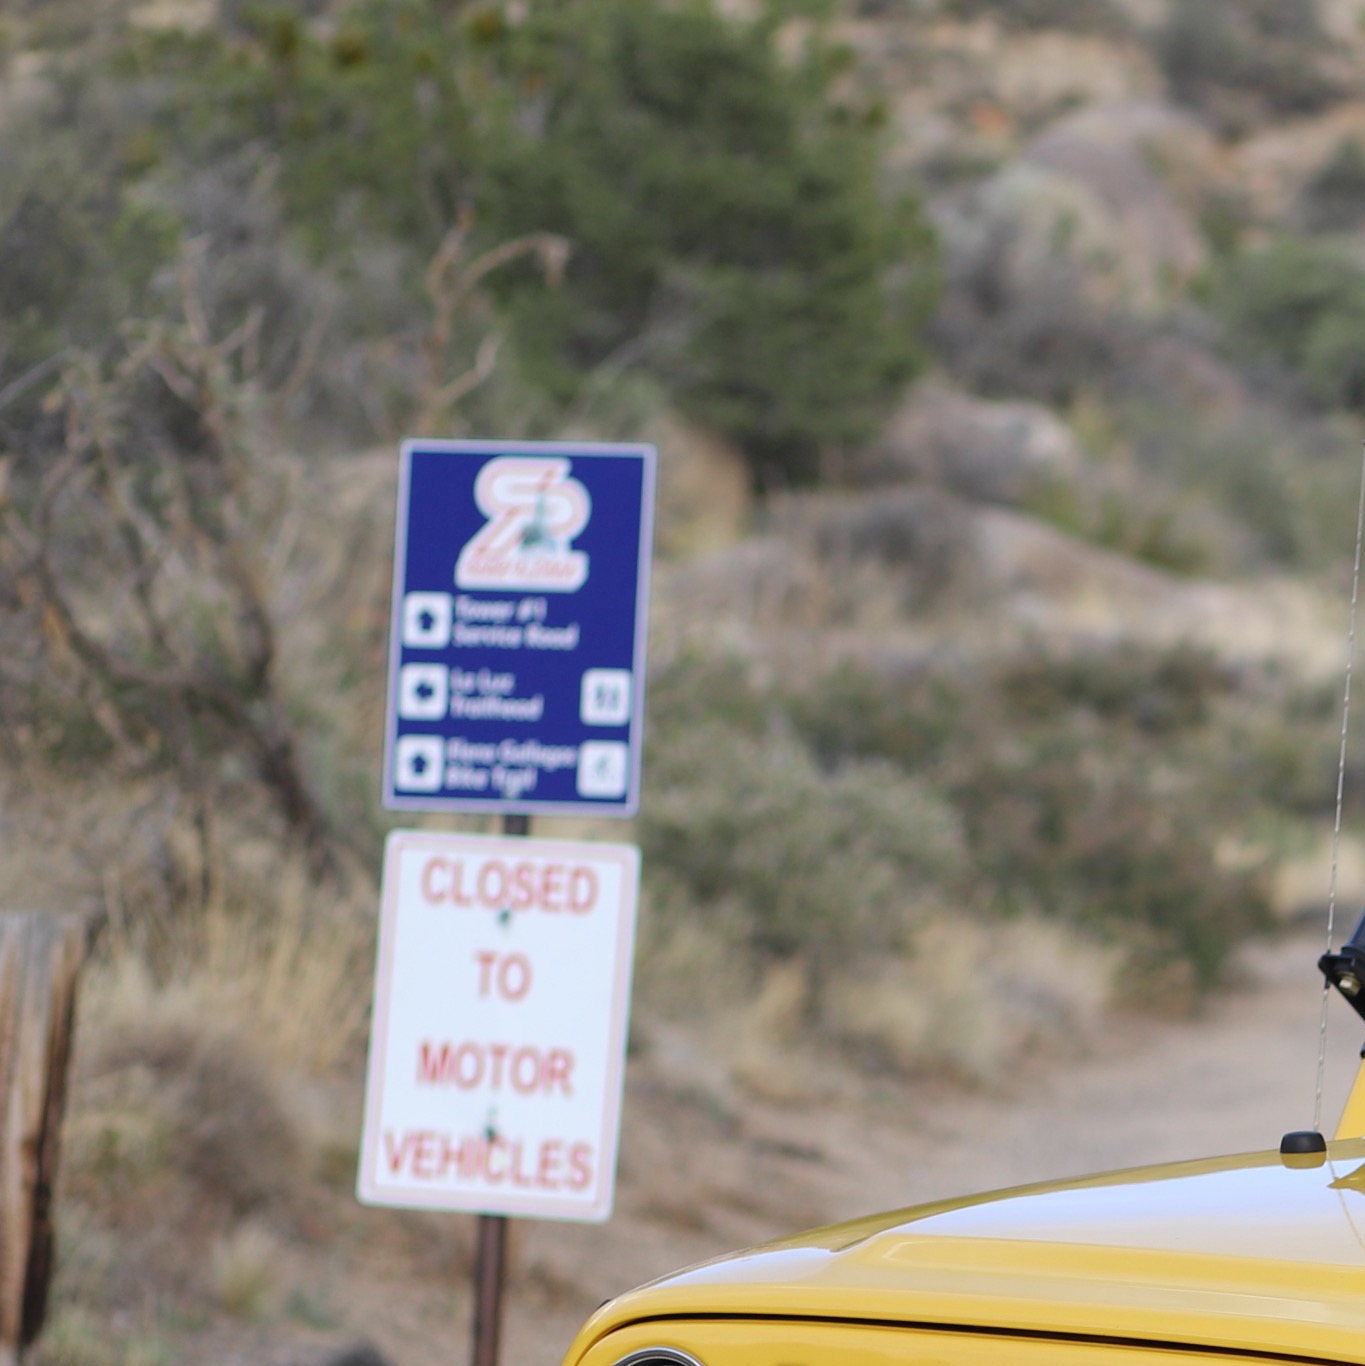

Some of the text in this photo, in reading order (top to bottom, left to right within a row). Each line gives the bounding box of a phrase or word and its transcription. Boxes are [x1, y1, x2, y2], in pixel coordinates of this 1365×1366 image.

[421, 857, 599, 915] CLOSED
[474, 949, 532, 1002] TO
[417, 1040, 576, 1097] MOTOR
[384, 1129, 594, 1192] VEHICLES
